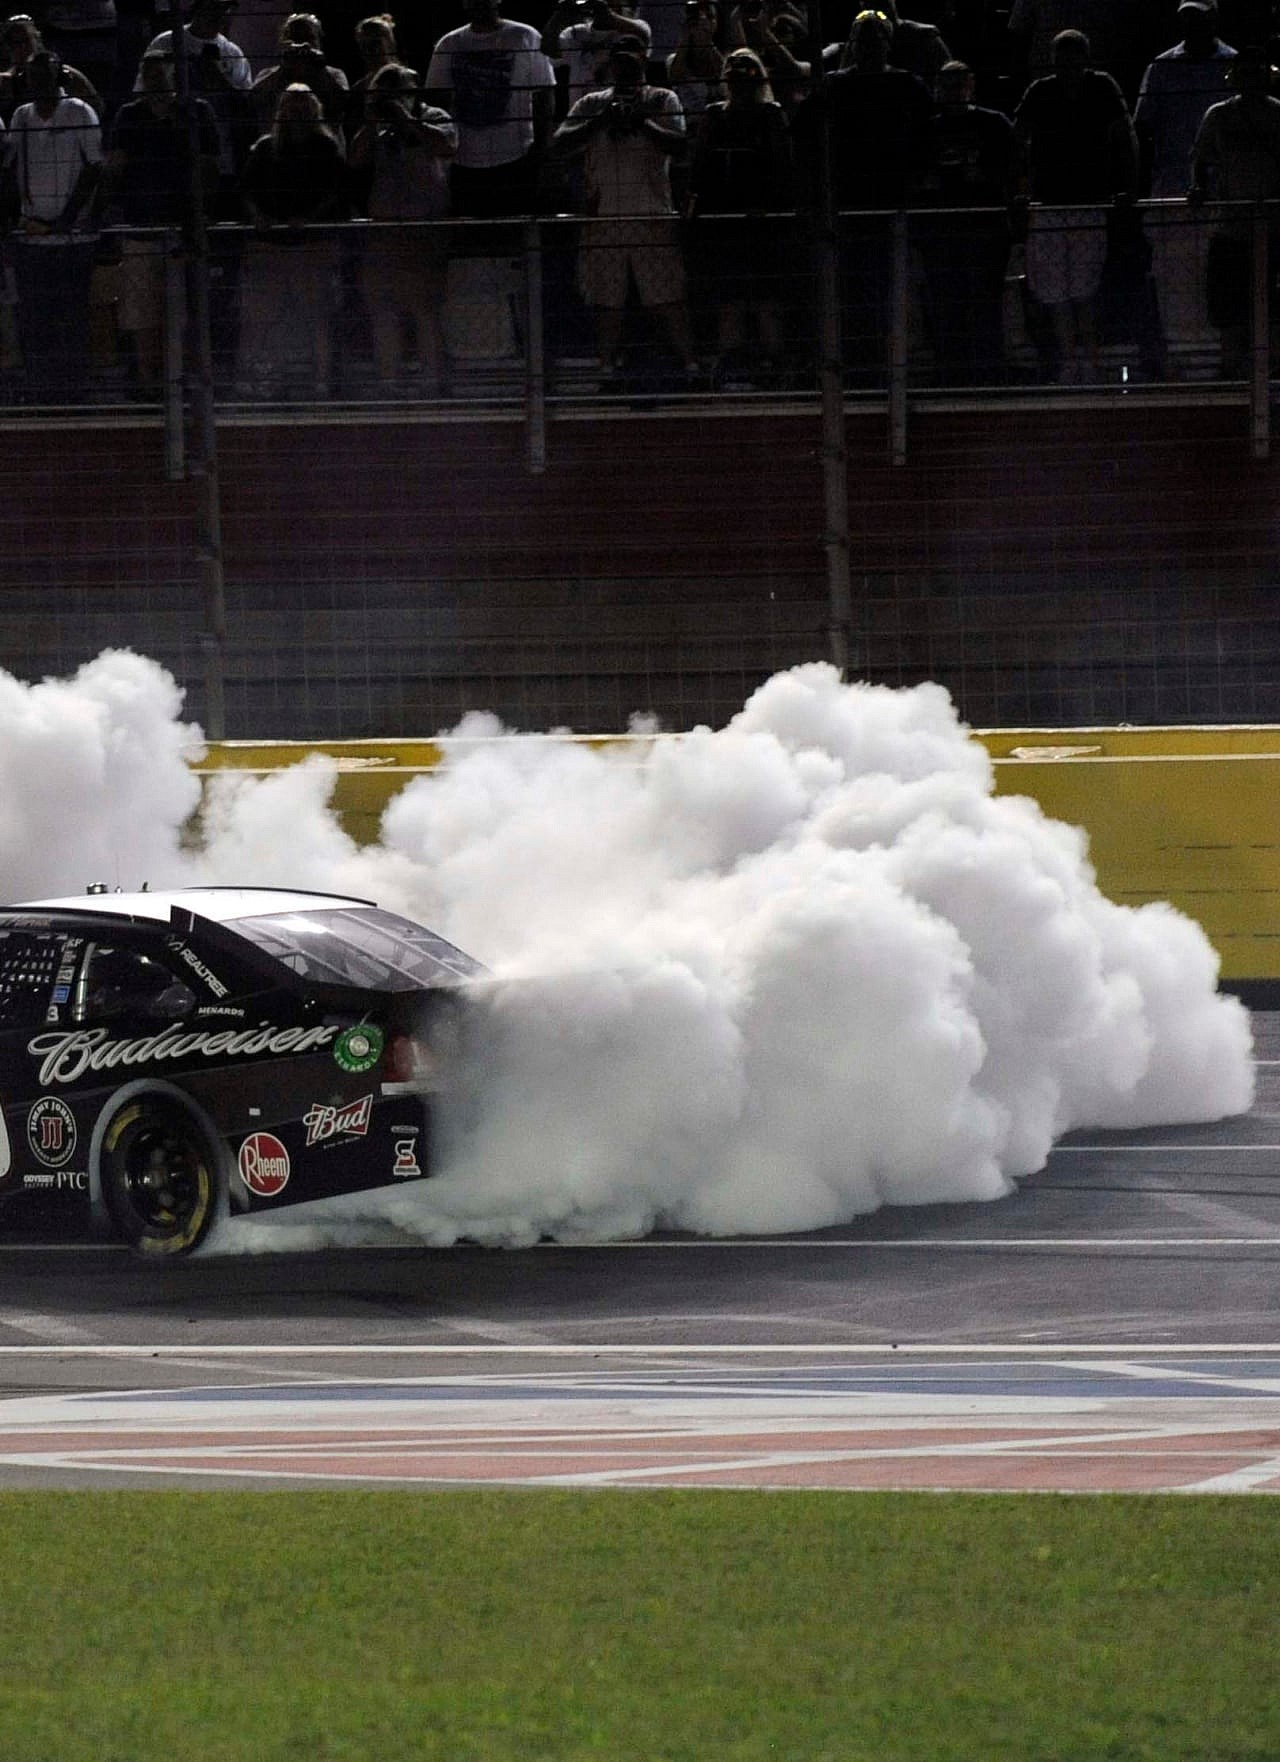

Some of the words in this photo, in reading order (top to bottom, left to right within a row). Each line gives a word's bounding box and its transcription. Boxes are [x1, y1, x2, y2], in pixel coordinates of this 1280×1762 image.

[180, 948, 229, 998] REALTREE
[198, 1007, 245, 1016] MENARDS
[27, 1021, 339, 1085] Budweiser
[303, 1101, 367, 1139] Bud
[57, 1171, 89, 1190] PTC
[243, 1136, 287, 1185] Rheem
